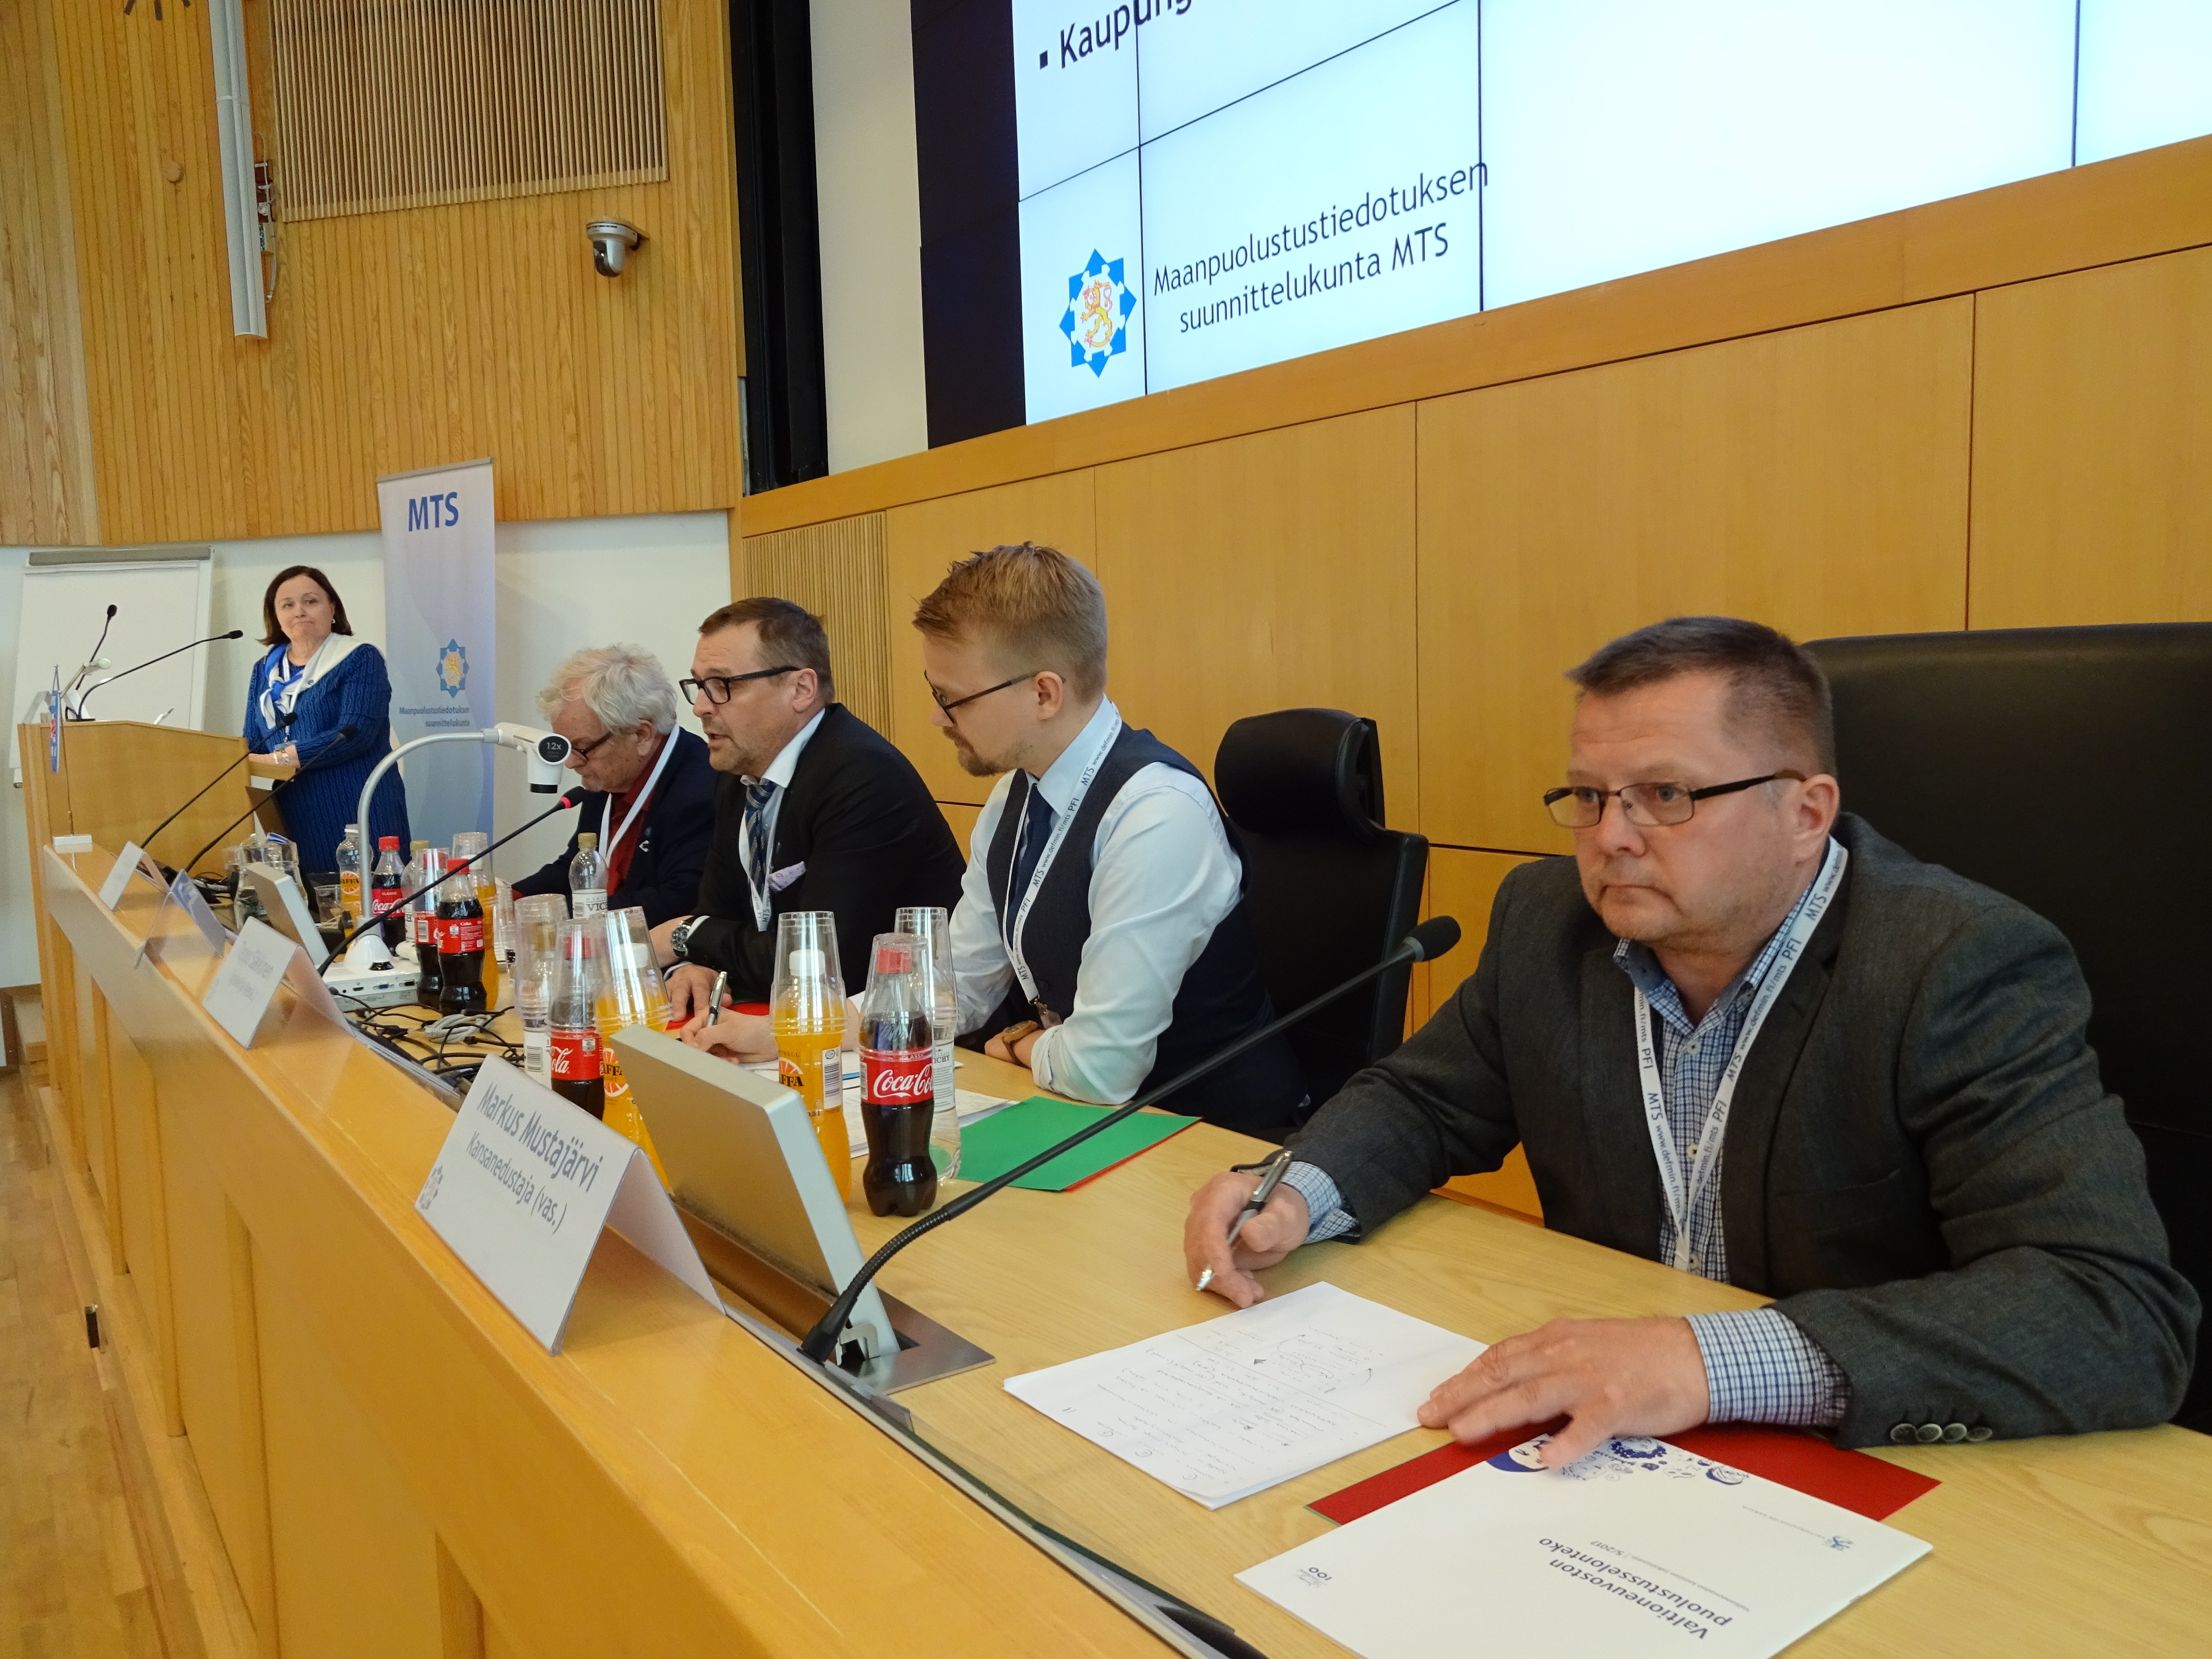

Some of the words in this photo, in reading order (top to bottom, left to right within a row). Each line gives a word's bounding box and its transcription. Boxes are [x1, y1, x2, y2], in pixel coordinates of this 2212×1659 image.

[1154, 162, 1488, 296] Maanpuolustustiedotuksen
[1180, 251, 1381, 333] suunnittelukunta
[1392, 222, 1448, 271] MTS
[408, 492, 459, 531] MTS
[399, 705, 470, 716] Maanpuolustustiedotuksen
[546, 742, 562, 750] 12x
[1080, 766, 1094, 786] MTS
[1033, 869, 1044, 887] MTS
[1042, 814, 1071, 868] www.defmin.fi/mts
[1068, 798, 1079, 811] PFI
[1021, 898, 1031, 912] PFI
[1805, 893, 1828, 921] MTS
[1018, 965, 1029, 980] MTS
[1638, 992, 1647, 1042] min.fi/mts
[1726, 1053, 1742, 1082] MTS
[1739, 964, 1787, 1050] www.defmin.fi/mts
[1781, 939, 1802, 961] PFI
[933, 1054, 950, 1064] ICHY
[1641, 1048, 1653, 1069] PFI
[1647, 1092, 1664, 1120] MTS
[1712, 1099, 1727, 1122] PFI
[476, 1082, 525, 1137] Markus
[518, 1111, 604, 1192] Mustajärvi
[466, 1130, 535, 1205] Kansanedustaja
[530, 1186, 568, 1235] (vas.)
[1589, 1540, 1624, 1556] 5/2017
[1308, 1567, 1332, 1581] 100
[1538, 1538, 1733, 1626] puolustusselonteko
[1549, 1559, 1709, 1640] Valtioneuvoston
